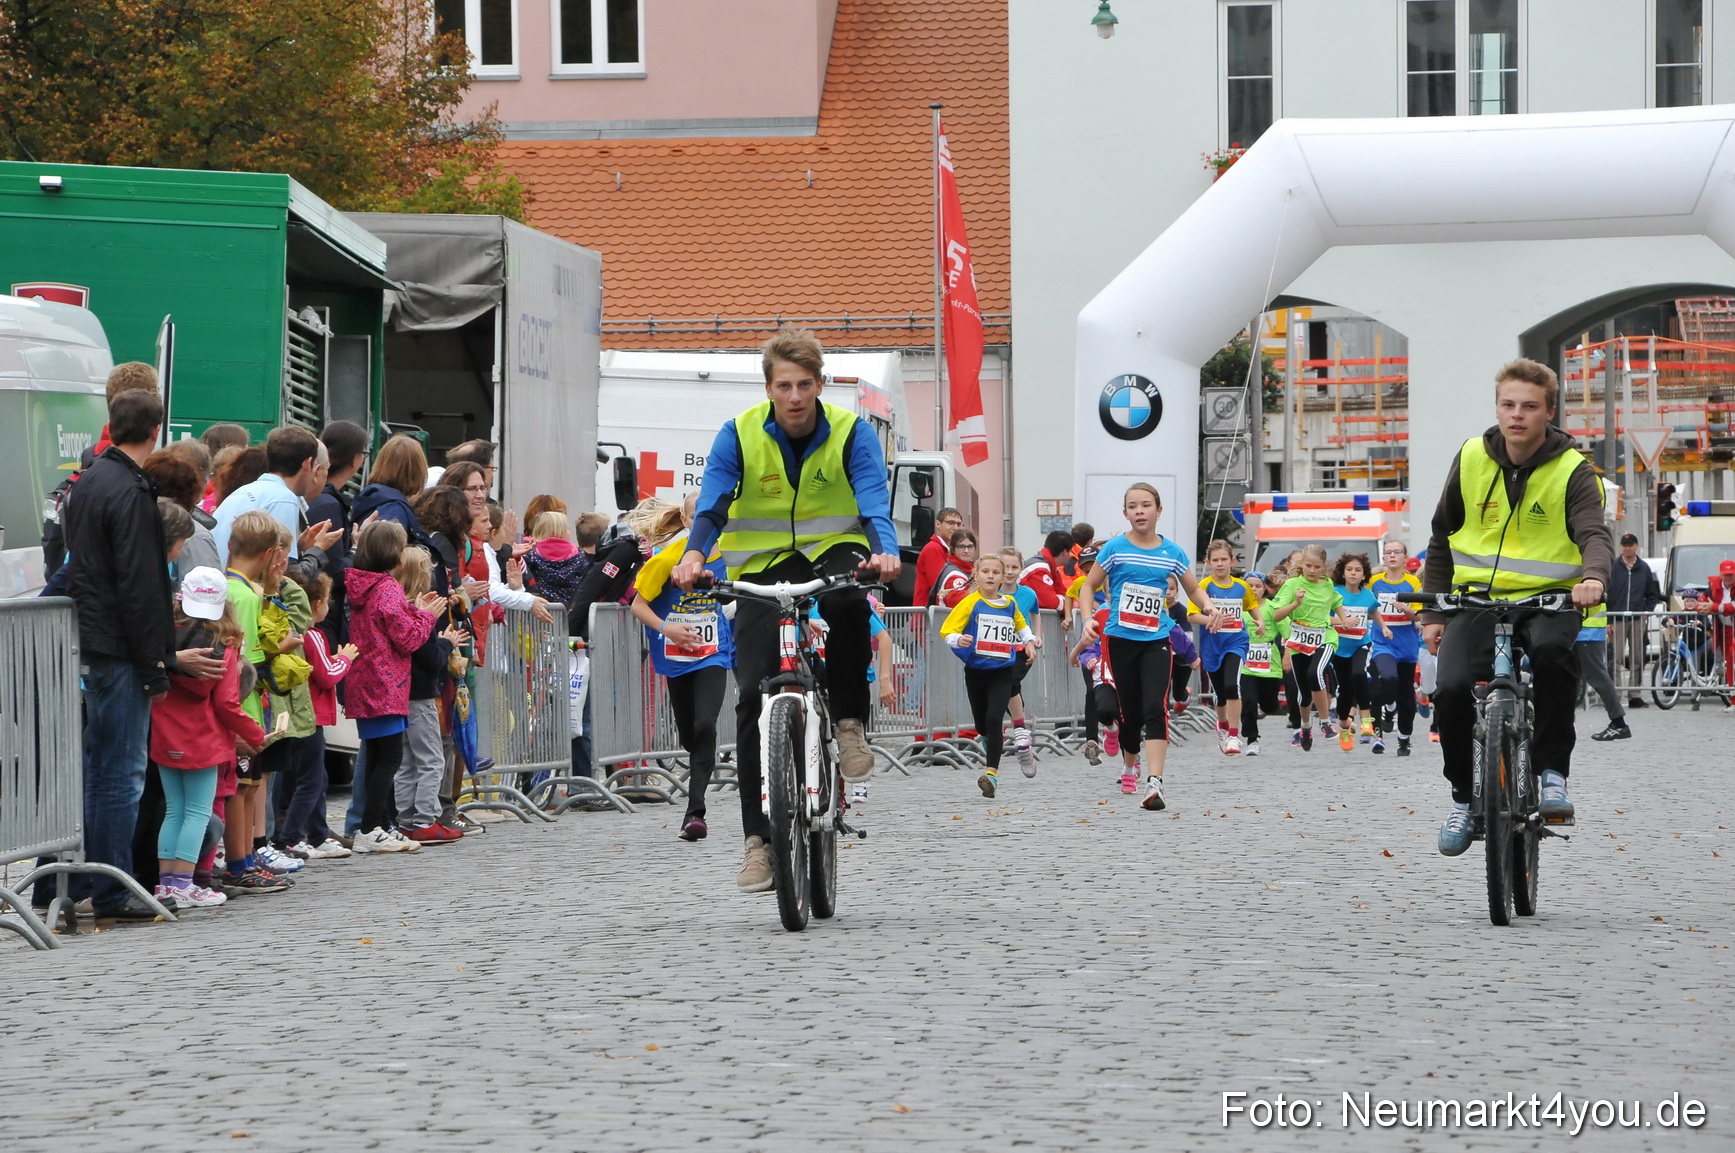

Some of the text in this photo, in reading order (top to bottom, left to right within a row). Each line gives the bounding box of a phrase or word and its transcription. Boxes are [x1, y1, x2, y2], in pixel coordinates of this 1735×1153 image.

[1104, 375, 1159, 398] BMW
[1218, 401, 1233, 413] 30
[685, 453, 706, 467] Ba
[684, 473, 703, 487] Ro
[1126, 594, 1161, 615] 7599
[1294, 630, 1322, 646] 7060
[1249, 650, 1268, 661] 004
